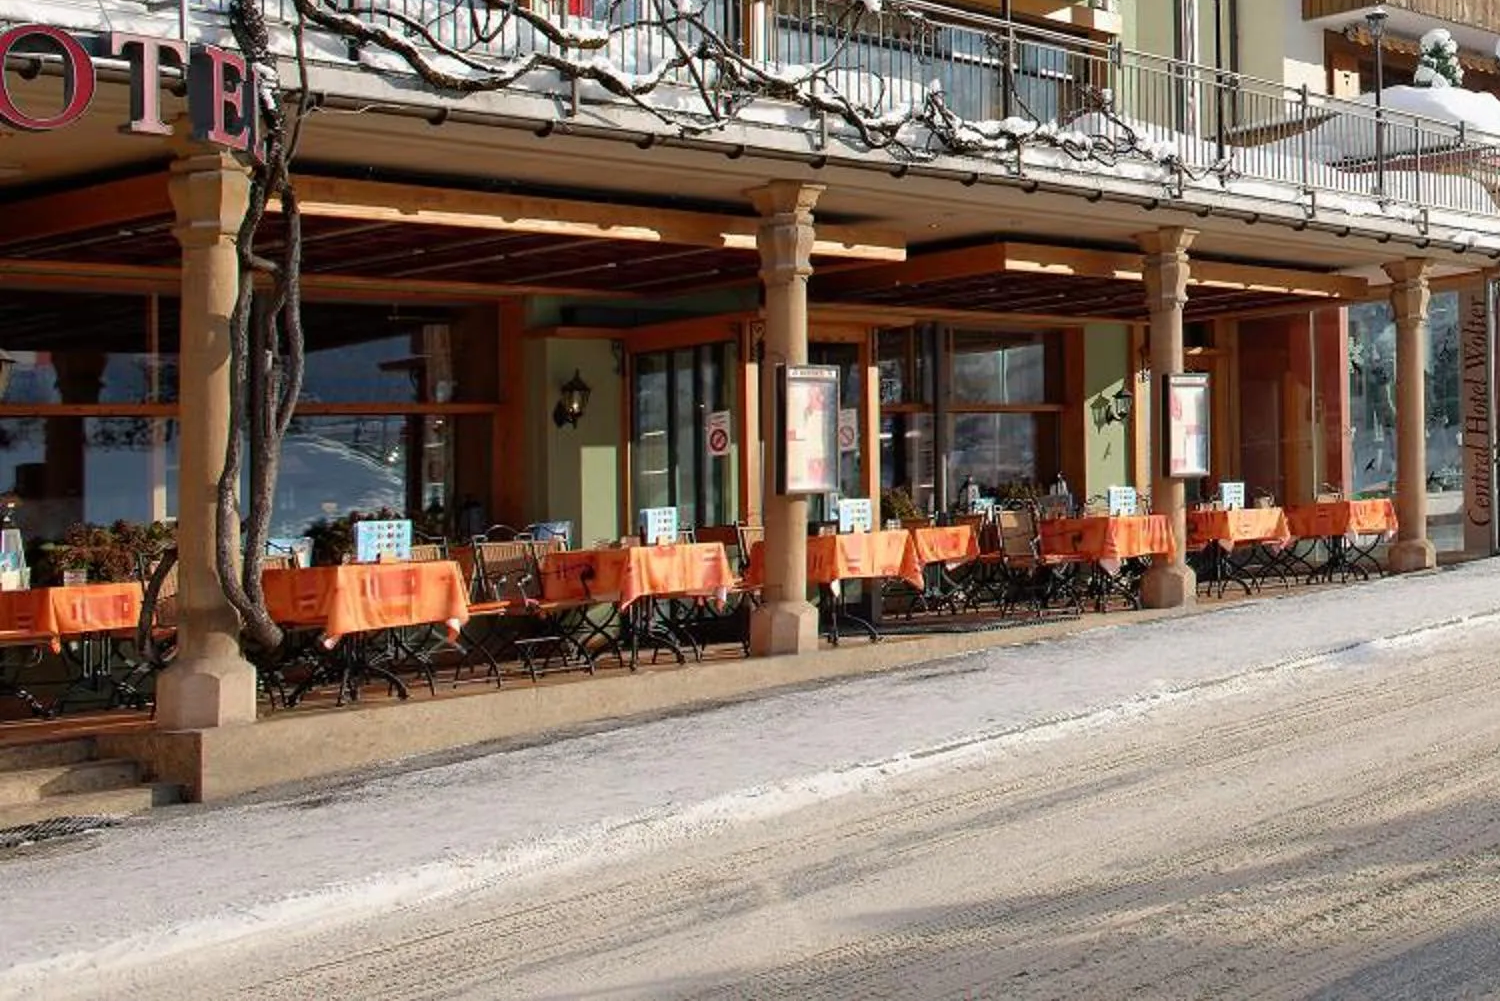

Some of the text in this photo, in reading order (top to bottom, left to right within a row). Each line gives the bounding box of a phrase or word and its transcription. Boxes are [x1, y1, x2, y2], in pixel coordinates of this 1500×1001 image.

[1462, 295, 1491, 526] Central Hotel Wolter
